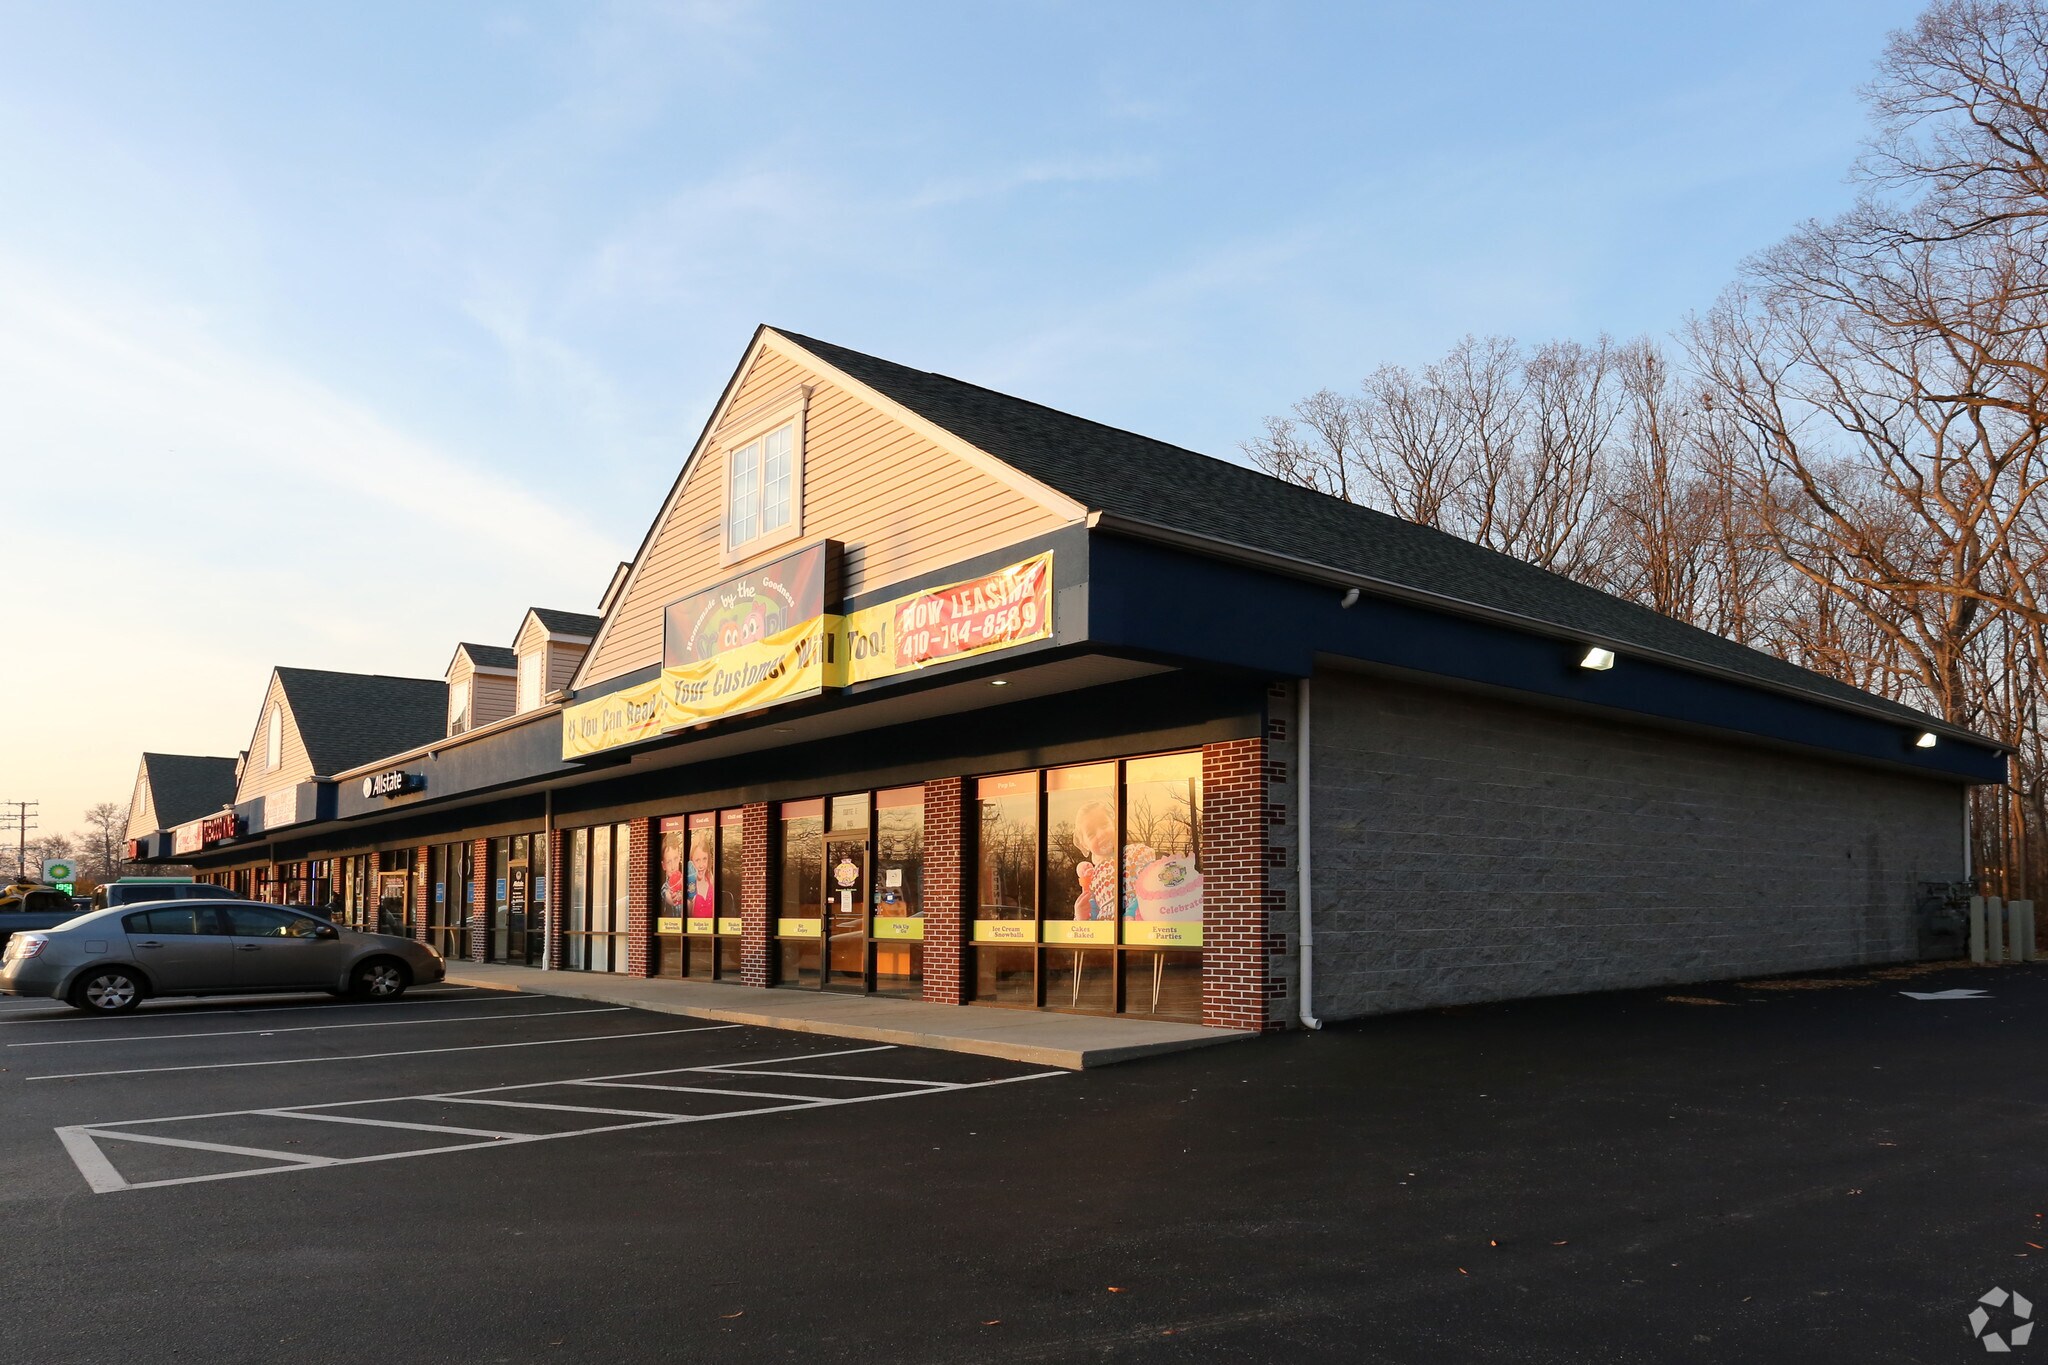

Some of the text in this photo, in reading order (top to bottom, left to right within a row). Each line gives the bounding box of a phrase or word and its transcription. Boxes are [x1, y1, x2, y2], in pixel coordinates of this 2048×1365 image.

[687, 576, 795, 651] Homemade Goodness
[720, 580, 757, 609] by the
[903, 571, 1037, 633] NOW LEASING
[902, 602, 1037, 658] 410-744-8589
[581, 715, 598, 738] You
[602, 707, 622, 732] Can
[626, 694, 656, 725] Read
[674, 679, 709, 706] Your
[713, 653, 787, 697] Customer
[794, 632, 835, 670] Will
[847, 622, 886, 662] Too!
[372, 770, 402, 796] Allstate
[1156, 932, 1182, 940] Parties
